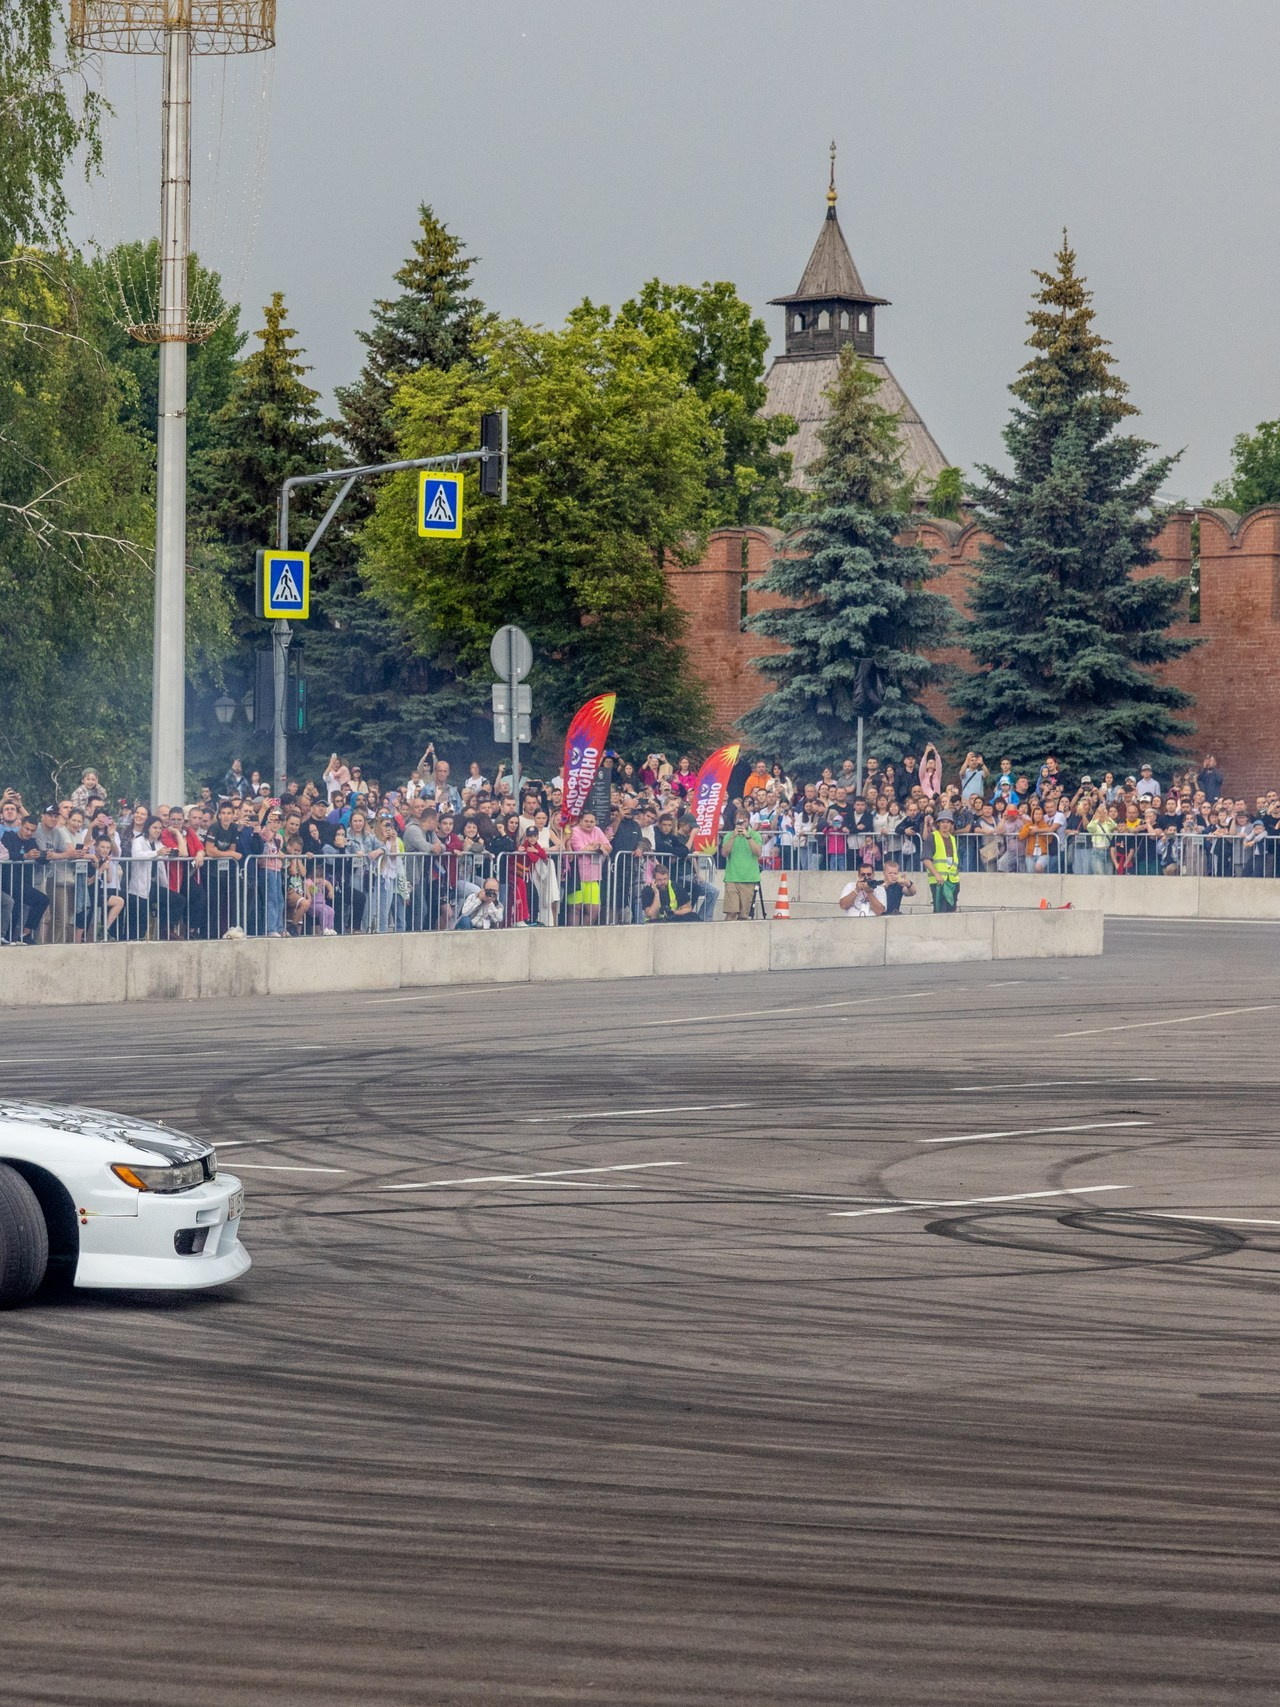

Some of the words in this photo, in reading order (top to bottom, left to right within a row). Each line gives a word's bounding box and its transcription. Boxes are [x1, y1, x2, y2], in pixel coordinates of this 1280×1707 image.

[566, 768, 581, 809] ЛЬФА
[570, 747, 598, 816] ВЫГОДНО
[701, 782, 722, 836] ВЫГОДНО
